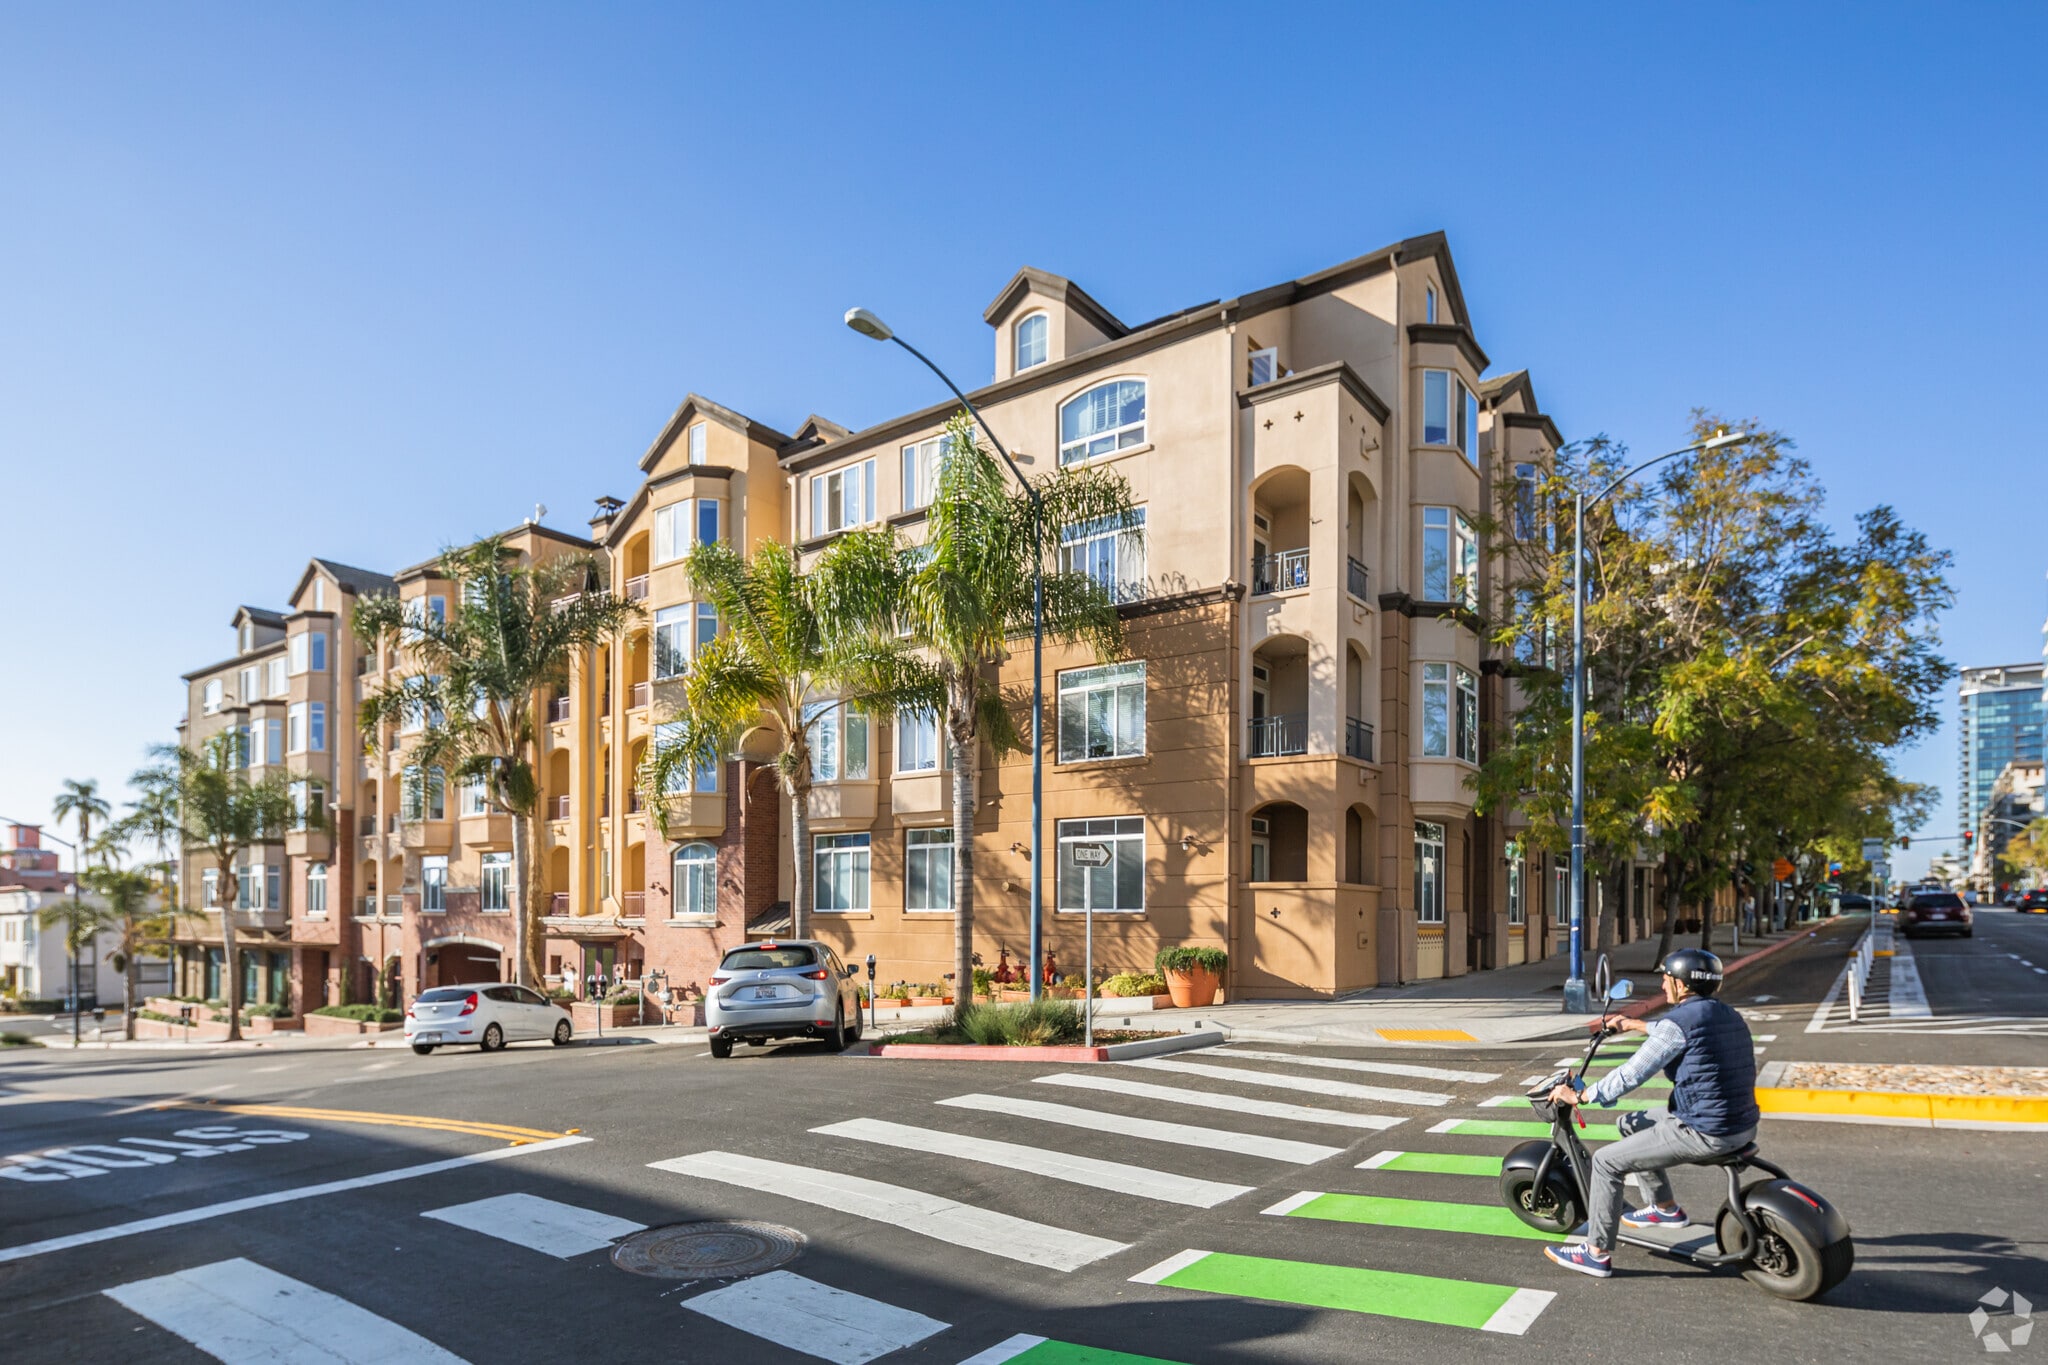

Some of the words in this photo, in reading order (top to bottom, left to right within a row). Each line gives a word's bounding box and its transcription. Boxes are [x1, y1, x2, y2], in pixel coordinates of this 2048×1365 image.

[1077, 849, 1088, 859] ONE
[1090, 849, 1101, 859] WAY
[0, 1126, 310, 1182] STOP
